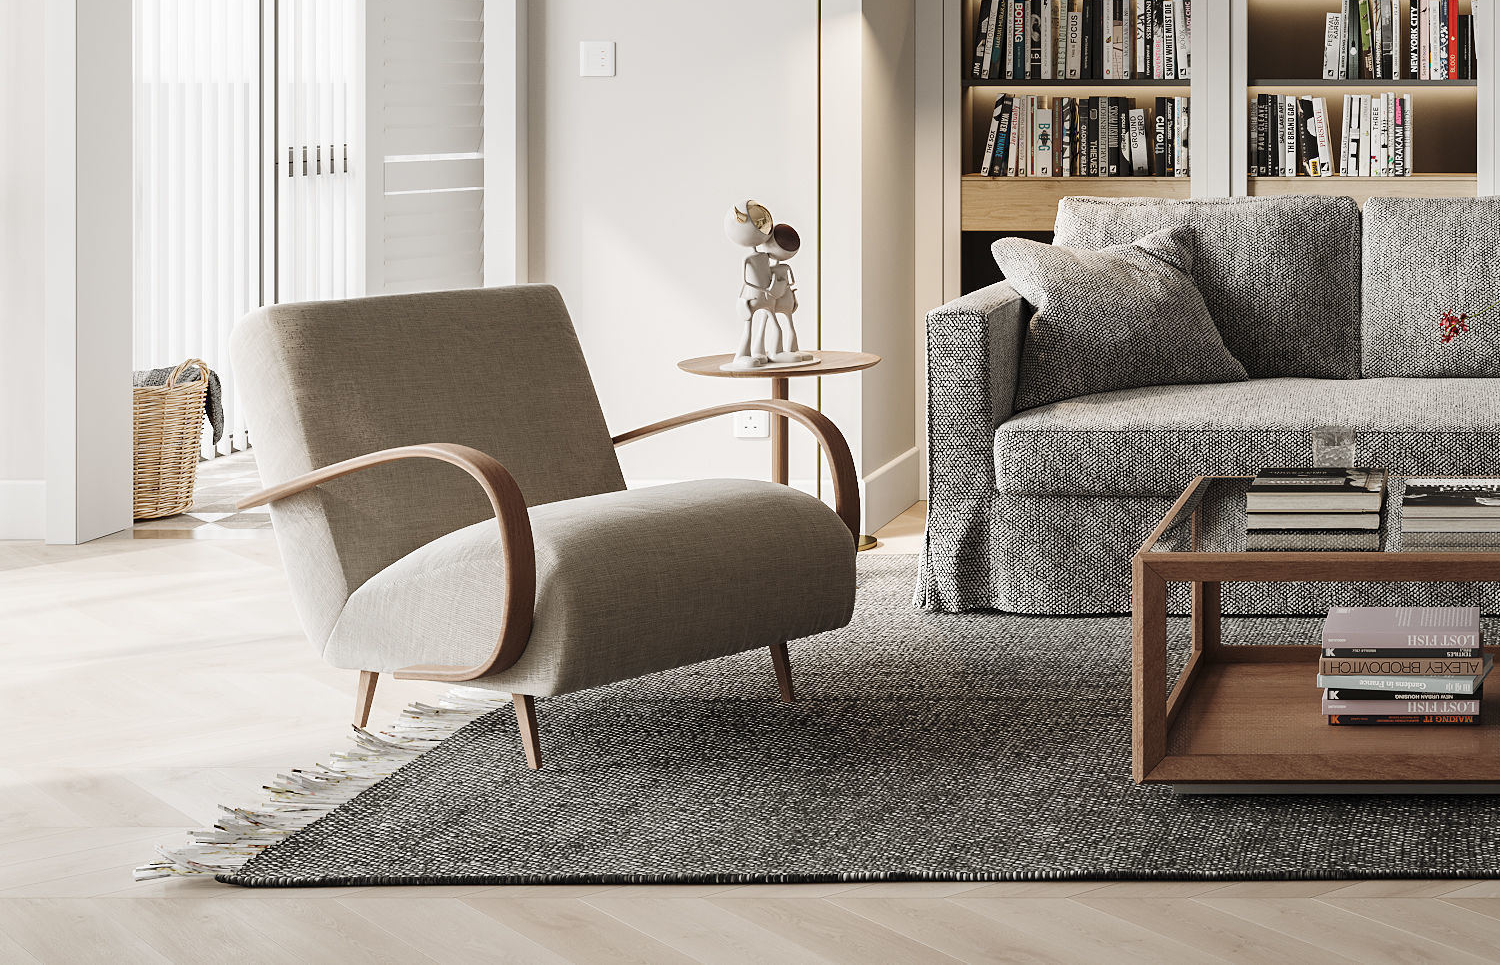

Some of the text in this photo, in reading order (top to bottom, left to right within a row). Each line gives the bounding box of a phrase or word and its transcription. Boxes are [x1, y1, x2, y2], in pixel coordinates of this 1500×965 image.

[995, 27, 1003, 48] HARUKI
[1014, 2, 1024, 43] BORING
[1327, 15, 1335, 47] FESTIVAL
[986, 23, 996, 55] FICTIONS
[1164, 3, 1174, 76] SNOW WHITE MUST DIE
[973, 62, 981, 76] JIM
[1010, 105, 1020, 130] actually
[1108, 105, 1118, 148] UNIVERSITY PHYSICS
[1129, 115, 1139, 149] GROUND
[1137, 115, 1145, 136] ZERO
[1257, 104, 1265, 151] PAUL CLEAVE
[1287, 102, 1295, 153] THE BRAND GAP
[1315, 108, 1326, 148] PERSERVE
[988, 130, 996, 143] SOX
[995, 113, 1009, 158] WATER FINANCE
[1395, 126, 1404, 175] MURAKAMI
[1089, 140, 1098, 174] THIEVES
[1407, 635, 1475, 646] LOST FISH
[1331, 661, 1480, 674] ALEXEY BRODOVITCH
[1359, 679, 1385, 688] France
[1396, 681, 1427, 690] Gardens
[1407, 701, 1475, 713] LOST FISH
[1435, 715, 1473, 723] MAKING
